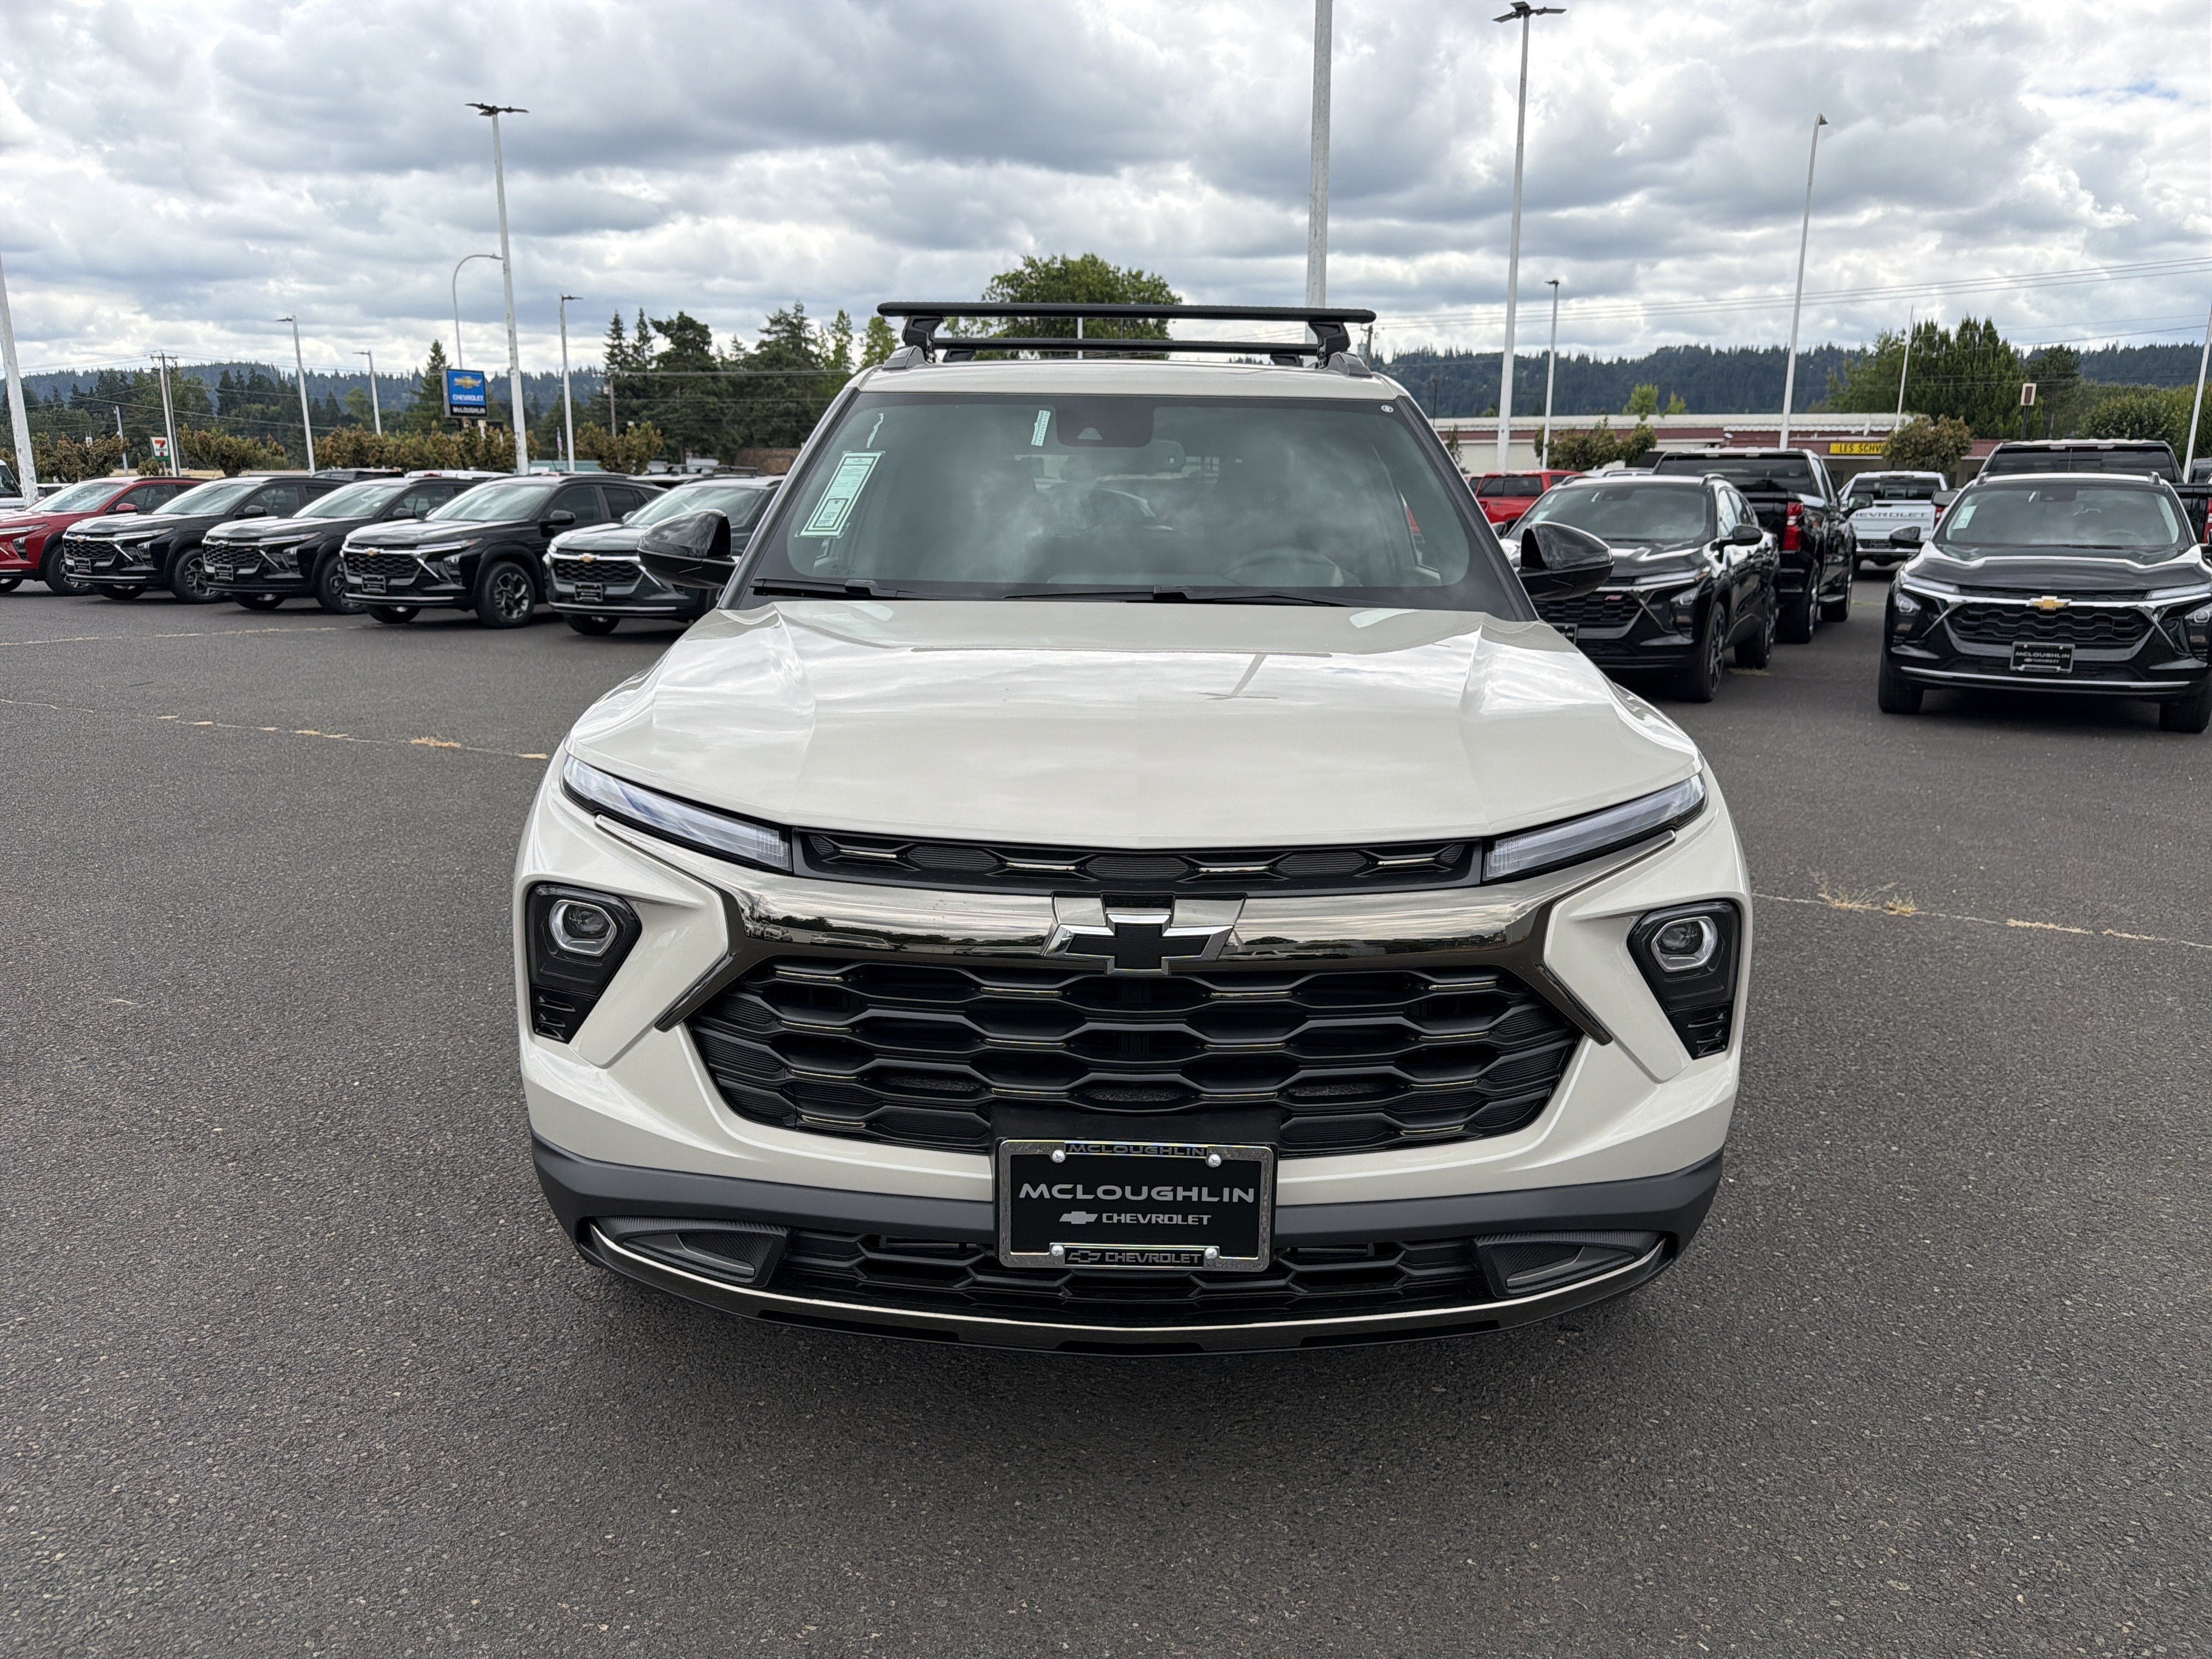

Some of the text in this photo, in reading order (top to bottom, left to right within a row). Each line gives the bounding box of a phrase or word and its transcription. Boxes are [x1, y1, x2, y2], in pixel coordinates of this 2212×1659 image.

[1069, 1144, 1205, 1156] MCLOUGHLIN
[1019, 1183, 1254, 1203] MCLOUGHLIN
[1102, 1213, 1212, 1224] CHEVROLET
[1105, 1252, 1202, 1263] CHEVROLET
